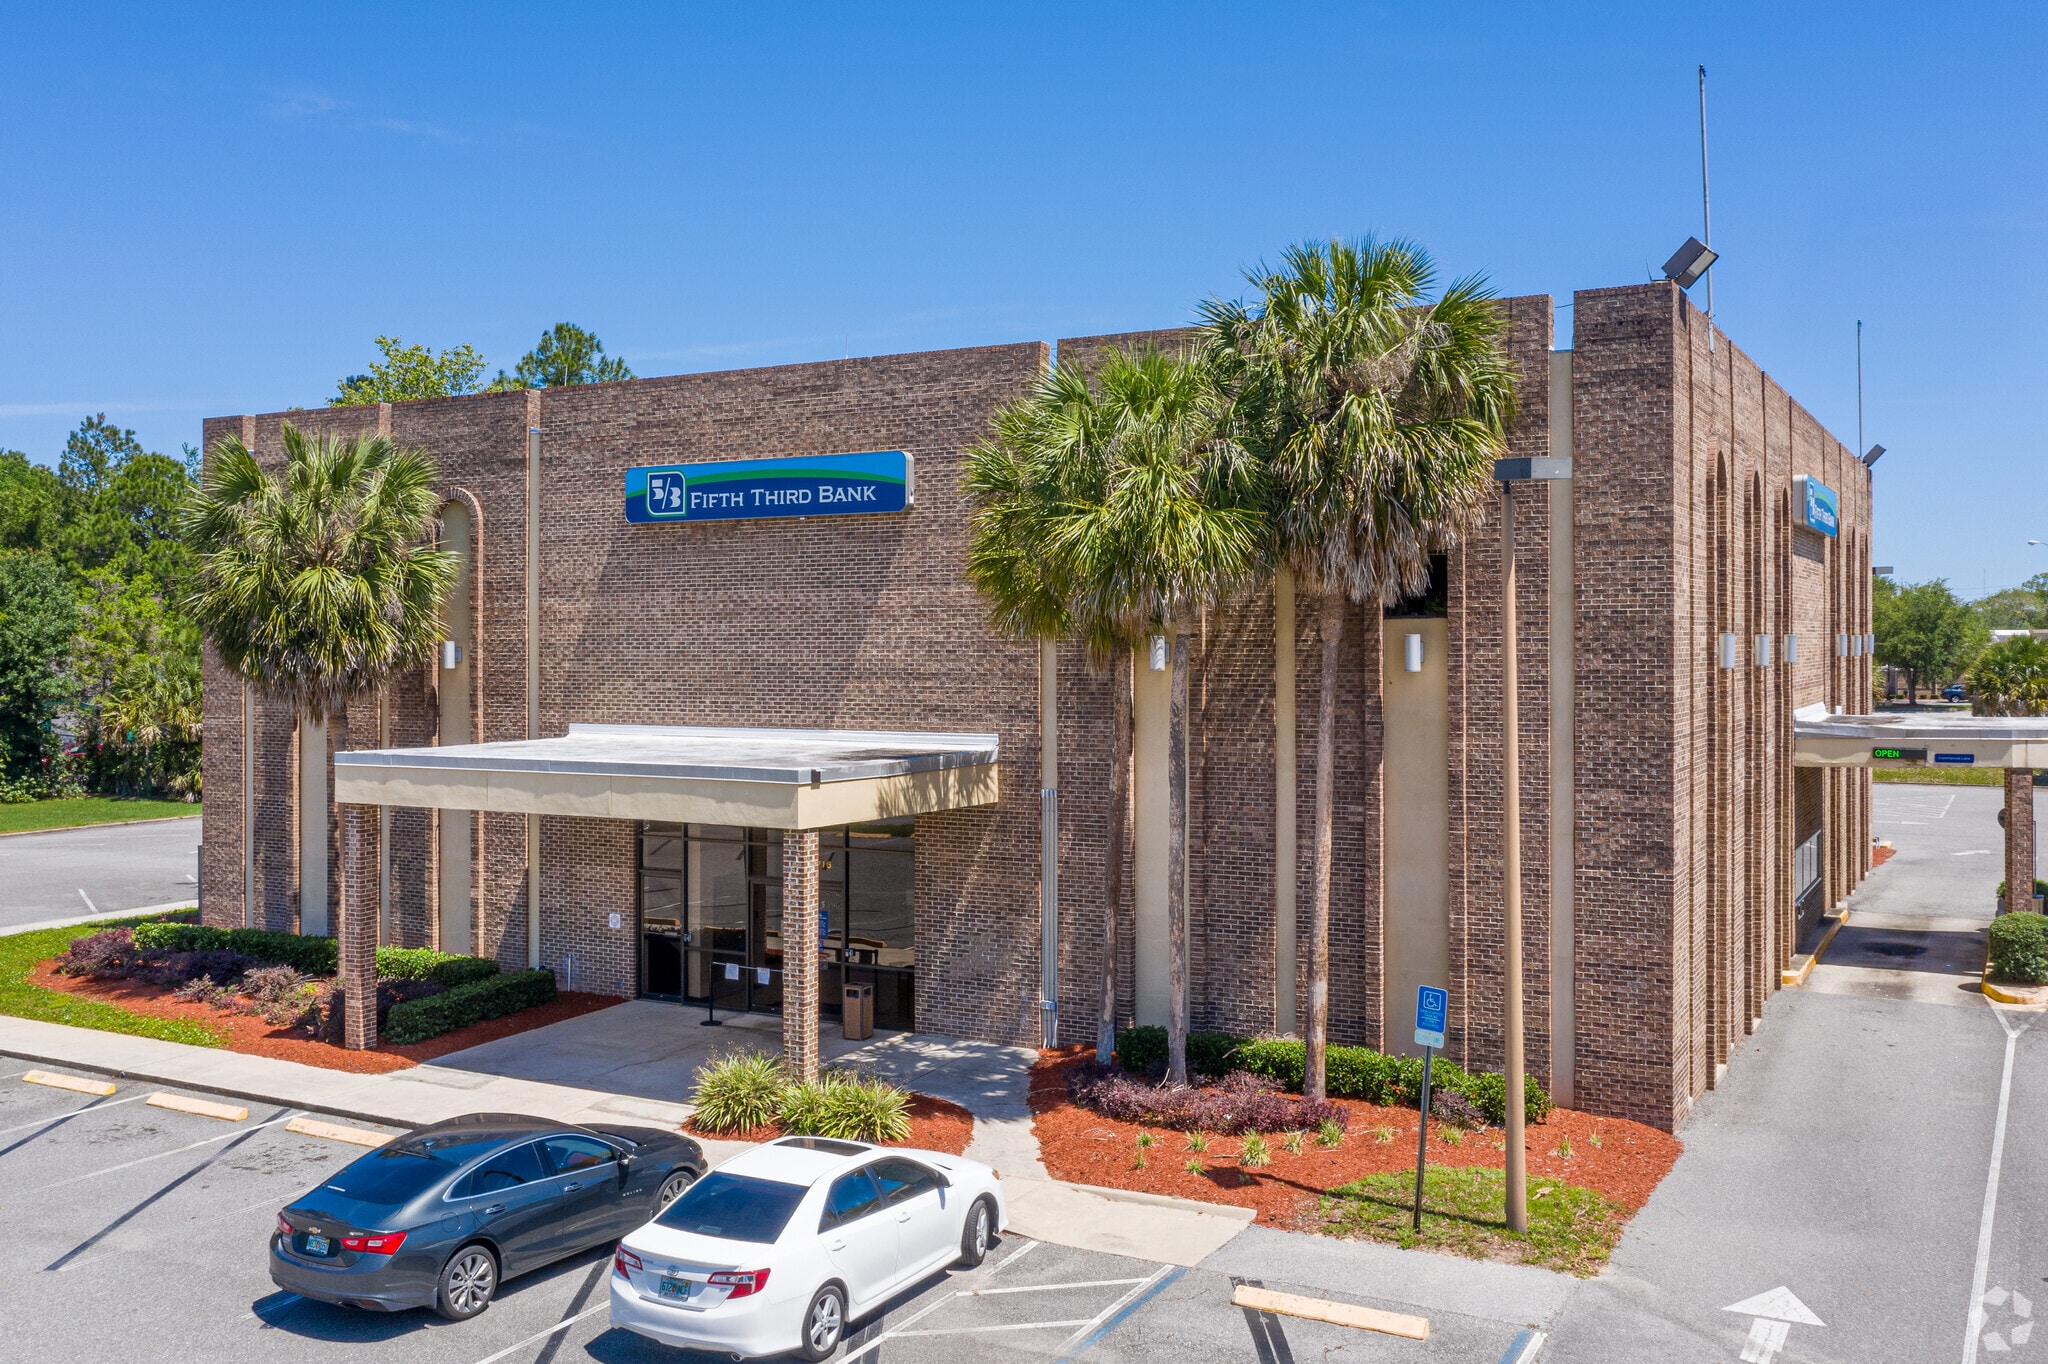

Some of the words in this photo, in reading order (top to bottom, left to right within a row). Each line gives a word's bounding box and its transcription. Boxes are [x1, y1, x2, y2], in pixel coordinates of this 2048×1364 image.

[690, 491, 744, 509] FIFTH
[750, 487, 812, 506] THIRD
[818, 485, 877, 504] BANK
[1874, 749, 1900, 758] OPEN
